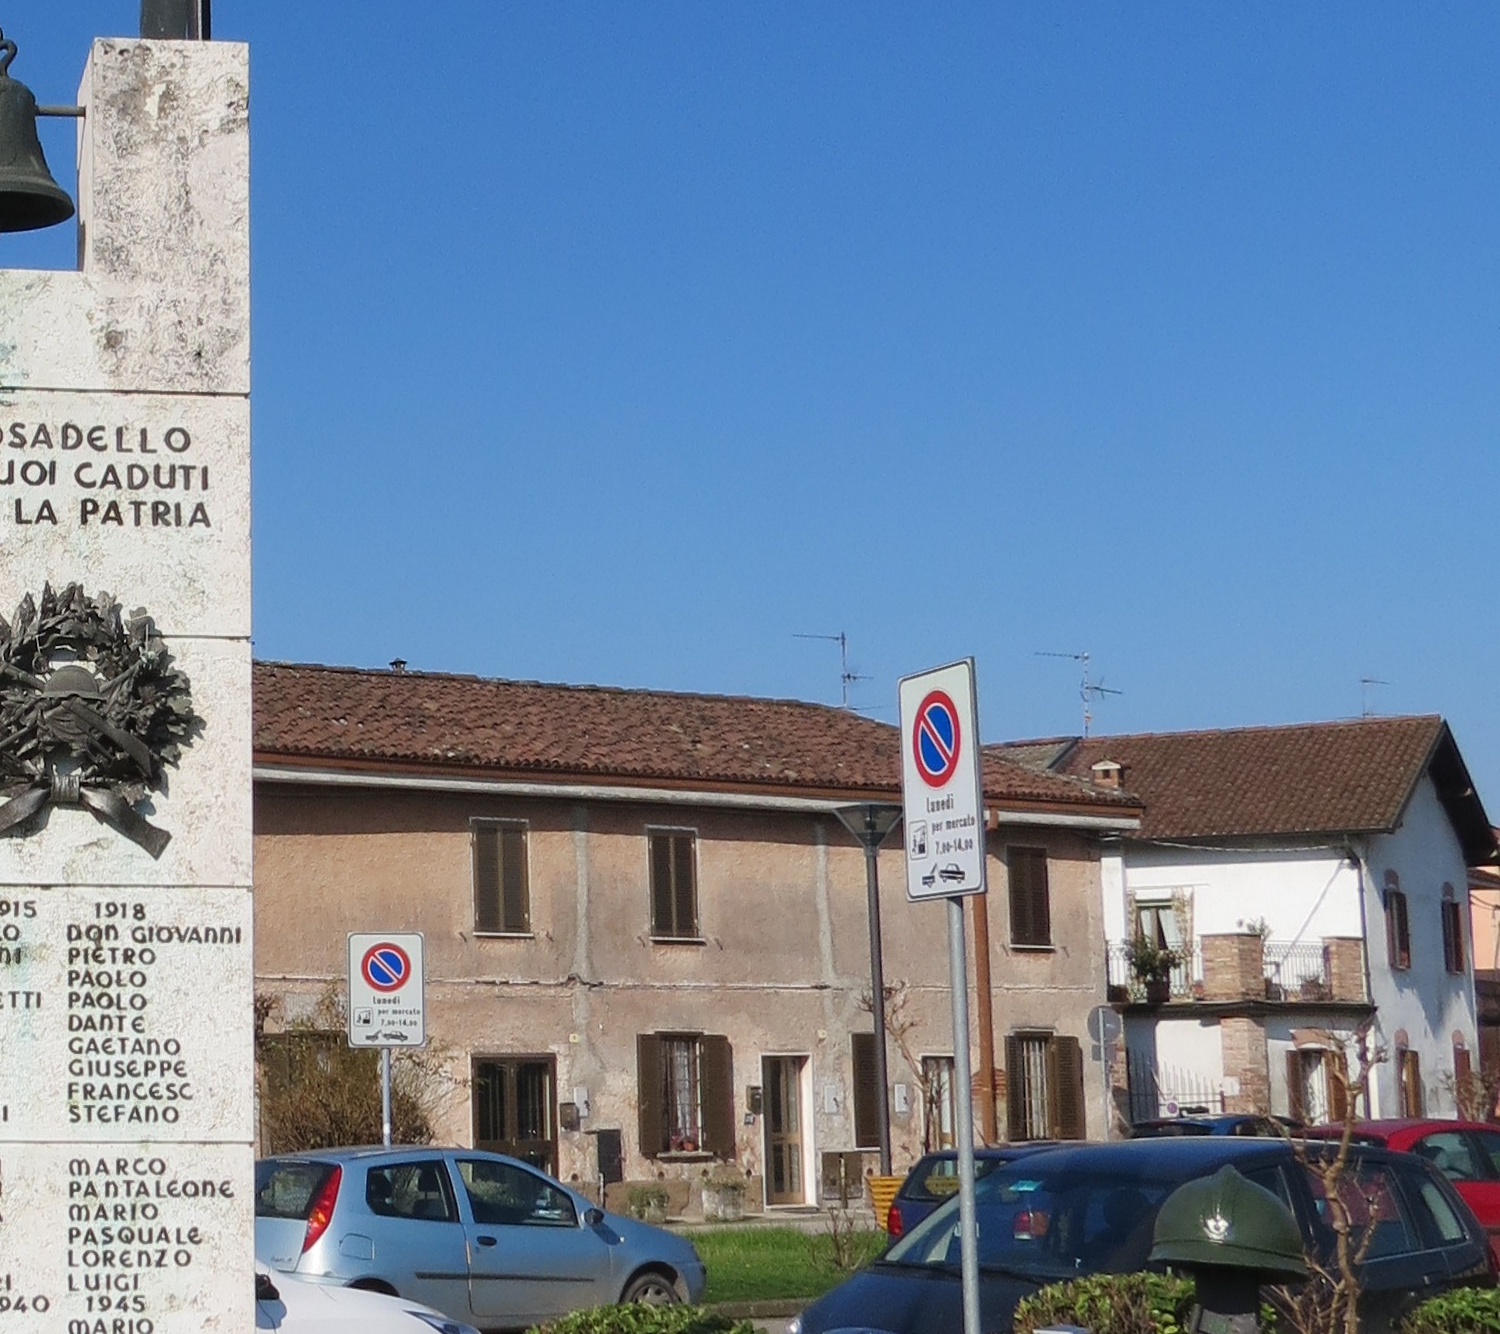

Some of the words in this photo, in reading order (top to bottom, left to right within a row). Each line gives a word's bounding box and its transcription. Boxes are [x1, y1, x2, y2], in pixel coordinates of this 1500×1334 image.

[74, 462, 209, 491] CADUTI
[14, 497, 58, 526] LA
[80, 497, 211, 528] PATRIA
[95, 902, 146, 921] 1918
[66, 924, 119, 943] DON
[131, 926, 241, 944] GIOVANNI
[68, 946, 156, 966] PIETRO
[67, 969, 147, 989] PAOLO
[68, 991, 148, 1011] PAOLO
[68, 1014, 145, 1034] DANTE
[68, 1037, 181, 1056] GAETANO
[68, 1058, 187, 1078] GIUSEPPE
[69, 1104, 179, 1123] STEFANO
[69, 1158, 166, 1176] MARCO
[69, 1180, 234, 1199] PANTALEONE
[68, 1203, 158, 1222] MARIO
[68, 1226, 202, 1246] PASQUALE
[68, 1249, 191, 1268] LORENZO
[68, 1274, 138, 1292] LUIGI
[87, 1295, 146, 1313] 1945
